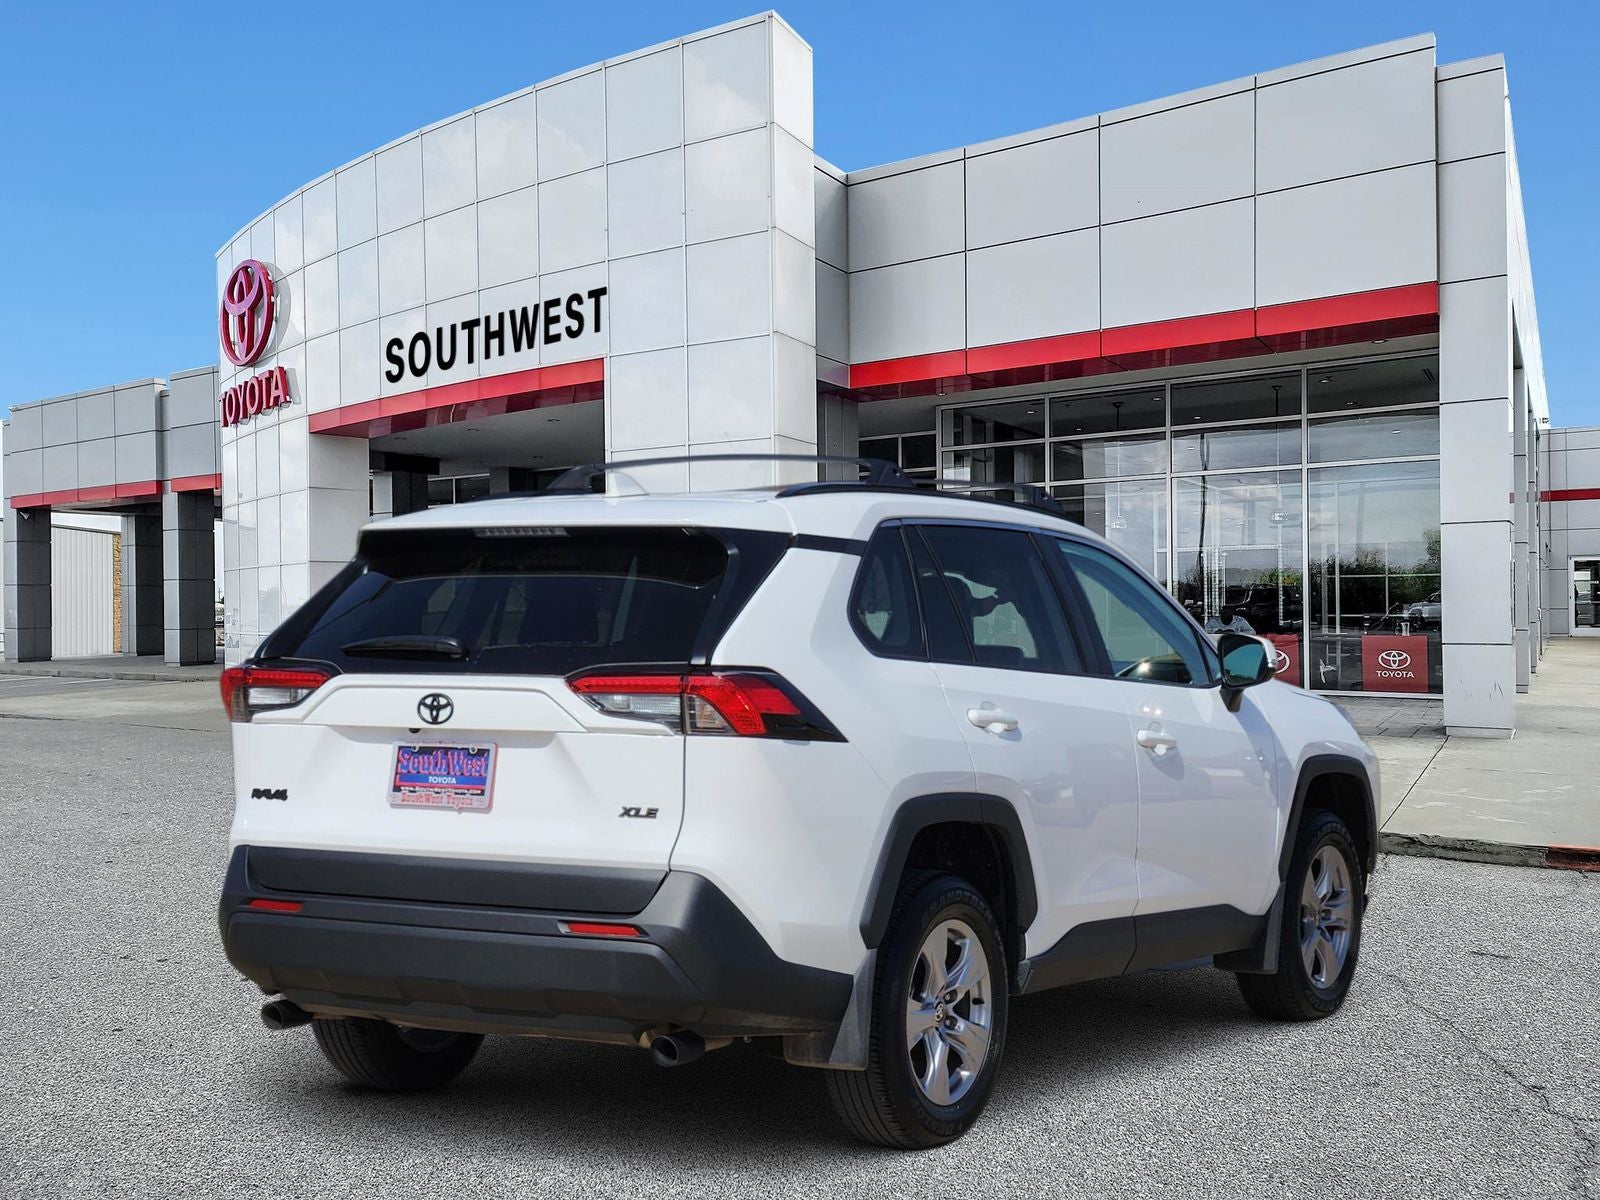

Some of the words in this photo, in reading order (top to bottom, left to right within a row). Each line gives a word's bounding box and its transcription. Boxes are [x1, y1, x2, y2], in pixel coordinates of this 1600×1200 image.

[385, 287, 607, 383] SOUTHWEST
[218, 366, 291, 427] TOYOTA
[1376, 670, 1415, 678] TOYOTA
[397, 748, 487, 776] SouthWest
[429, 776, 457, 784] TOYOTA
[619, 806, 659, 819] XLE
